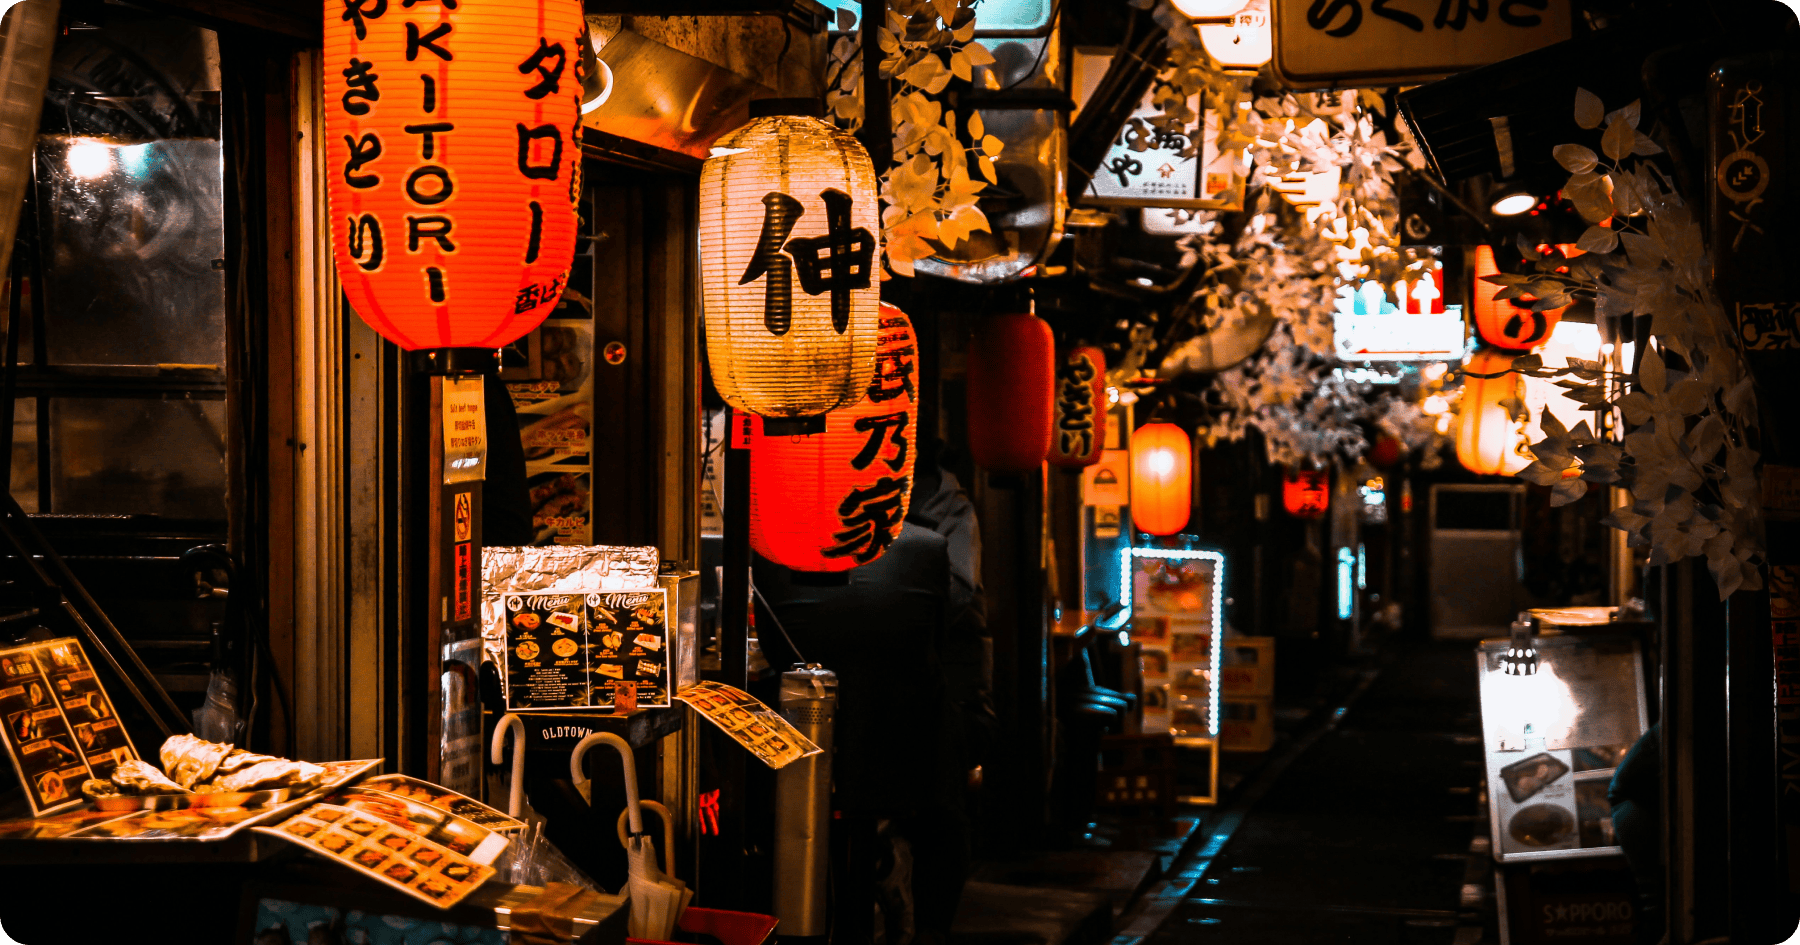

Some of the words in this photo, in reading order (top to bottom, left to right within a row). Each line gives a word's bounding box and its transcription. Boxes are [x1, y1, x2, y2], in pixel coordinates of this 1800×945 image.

[341, 0, 387, 271] やきとり
[404, 0, 458, 303] KITORI
[516, 36, 567, 264] タロー
[738, 187, 876, 337] 伸
[546, 517, 585, 527] 牛カルビ
[526, 594, 571, 611] Menu
[605, 592, 650, 609] Menu
[542, 725, 593, 740] OLDTOWN
